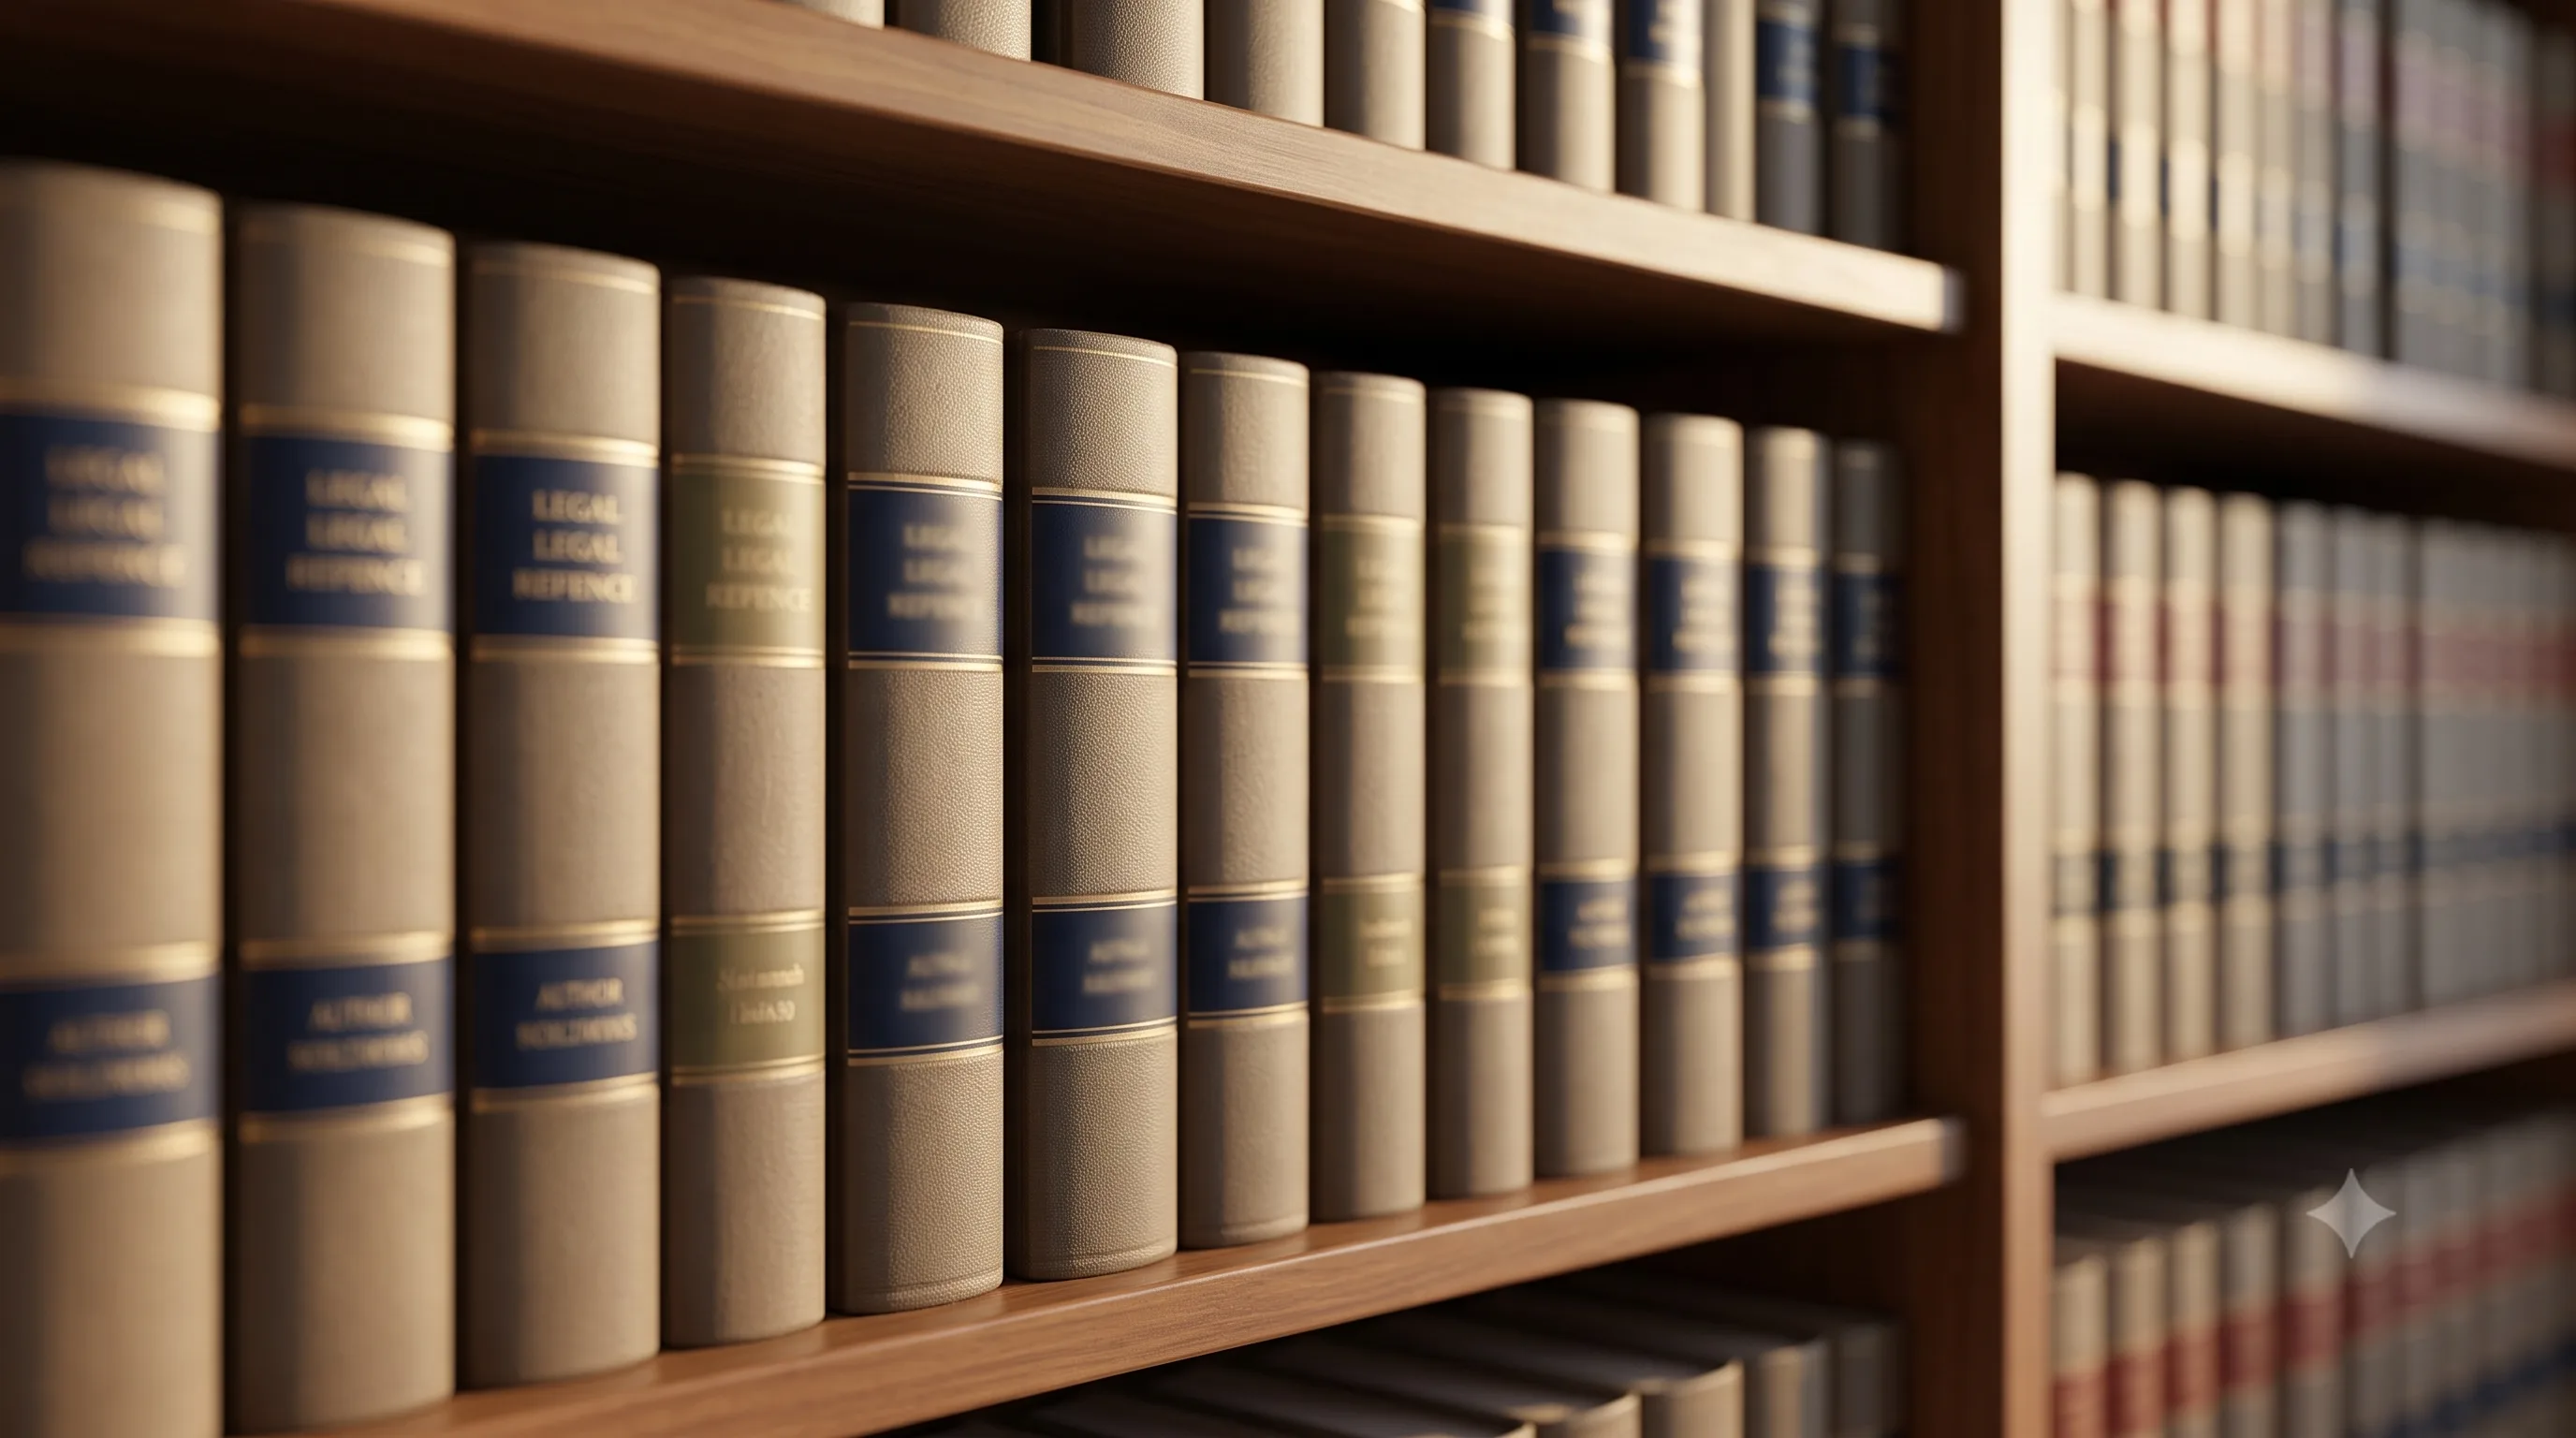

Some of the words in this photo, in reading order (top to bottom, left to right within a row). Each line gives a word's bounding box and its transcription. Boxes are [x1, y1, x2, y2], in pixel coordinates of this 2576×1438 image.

[533, 490, 622, 524] LEGAL
[722, 508, 798, 537] LEGAL
[533, 530, 622, 563] LEGAL
